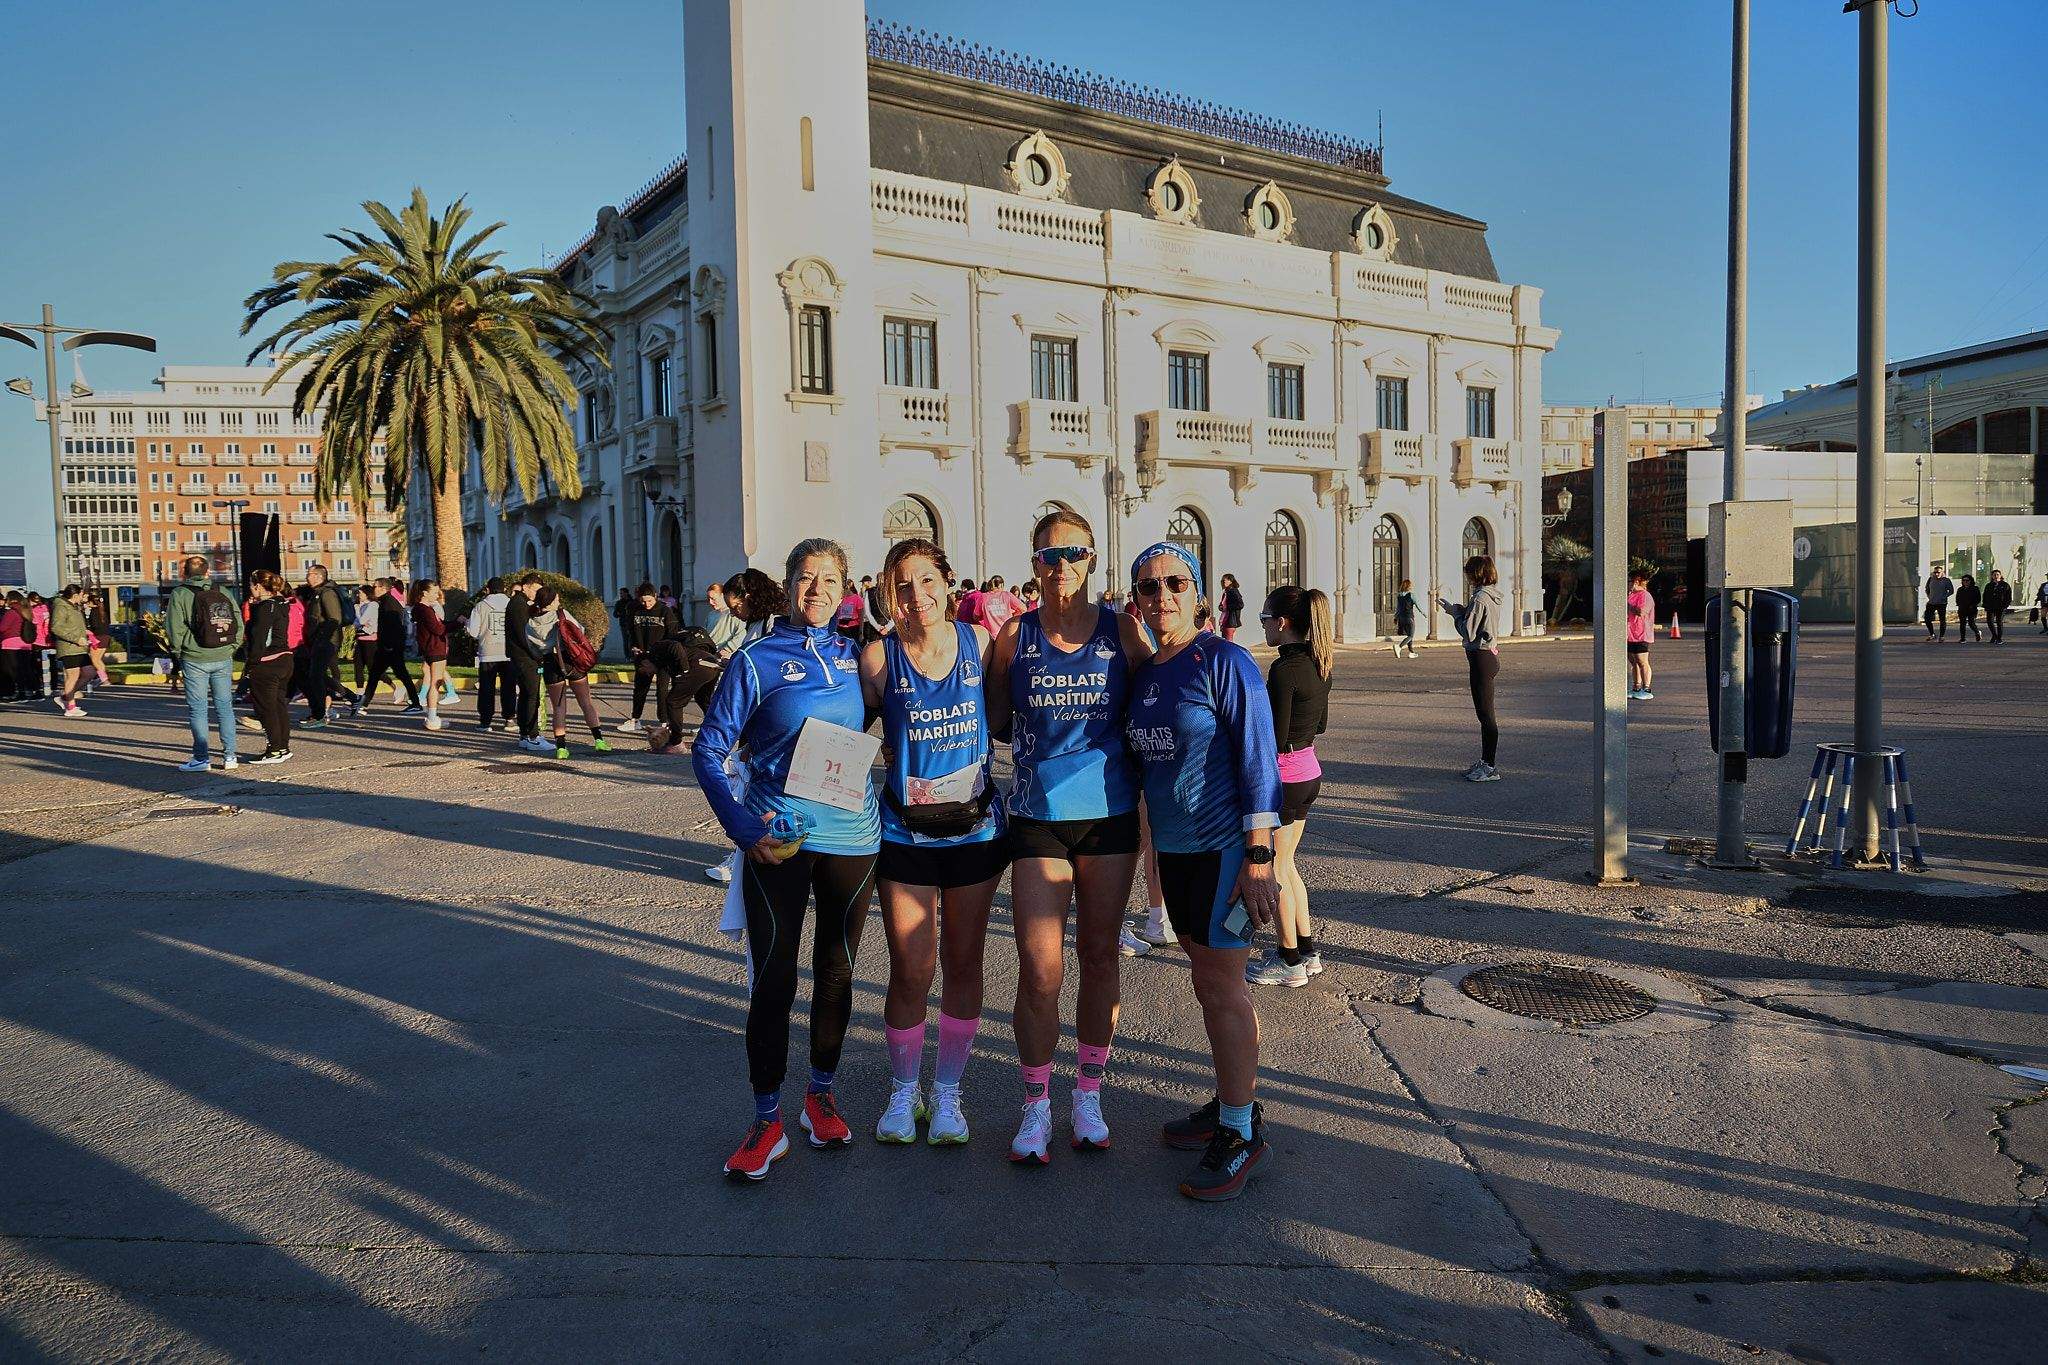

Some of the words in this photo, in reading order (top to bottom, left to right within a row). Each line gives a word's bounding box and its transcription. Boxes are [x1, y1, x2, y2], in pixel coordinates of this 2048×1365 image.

[1028, 665, 1049, 674] C.A.
[1031, 673, 1107, 689] POBLATS
[904, 700, 925, 709] C.A.
[1028, 689, 1110, 708] MARÍTIMS
[909, 700, 976, 724] POBLATS
[1052, 706, 1109, 721] València
[908, 718, 978, 742] MARÍTIMS
[930, 735, 978, 754] València
[1227, 1149, 1249, 1177] HOKA
